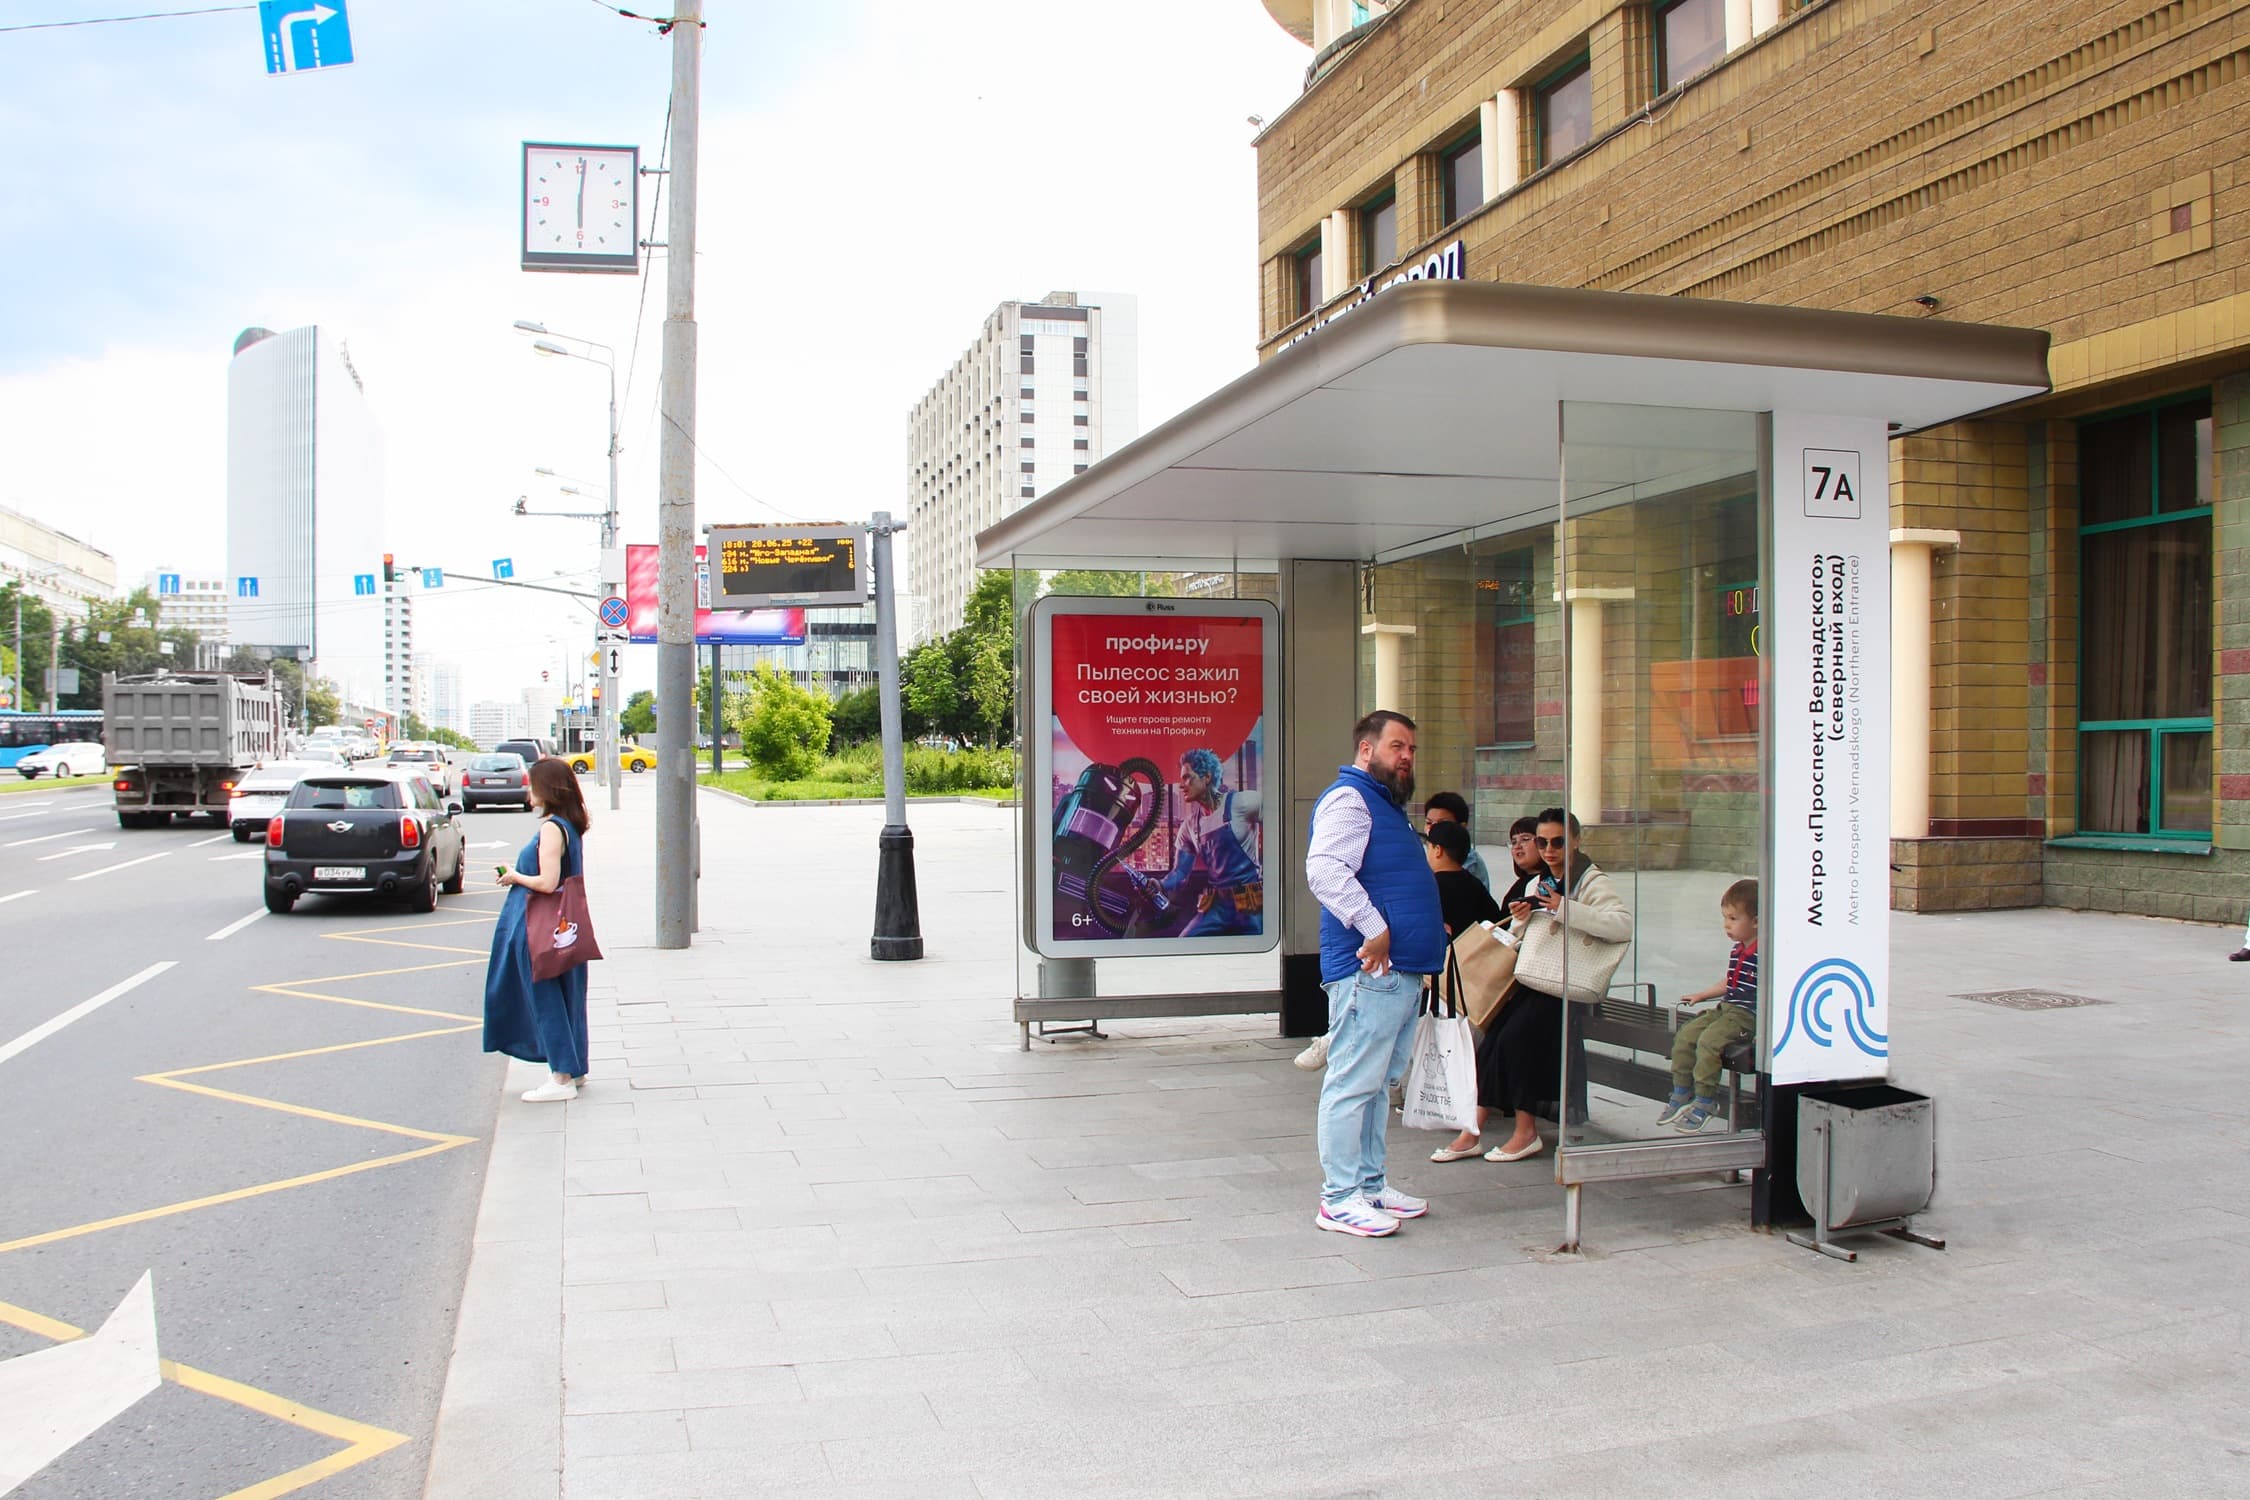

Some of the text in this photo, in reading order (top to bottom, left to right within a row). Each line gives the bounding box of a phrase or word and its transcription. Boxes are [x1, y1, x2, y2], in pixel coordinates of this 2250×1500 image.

[542, 196, 550, 207] 9
[612, 199, 620, 209] 3
[576, 231, 585, 241] 6
[1826, 554, 1846, 741] (северный вход)
[1077, 664, 1240, 681] Пылесос зажил
[1078, 687, 1238, 704] своей жизнью?
[1106, 715, 1212, 726] Ищите героев ремонта
[1111, 726, 1206, 738] техники на Профи.ру
[1808, 553, 1827, 926] Метро «Проспект Вернадского»
[1848, 554, 1862, 925] Metro Prospekt Vernadskogo (Northern Entrance)
[1072, 913, 1093, 927] 6+
